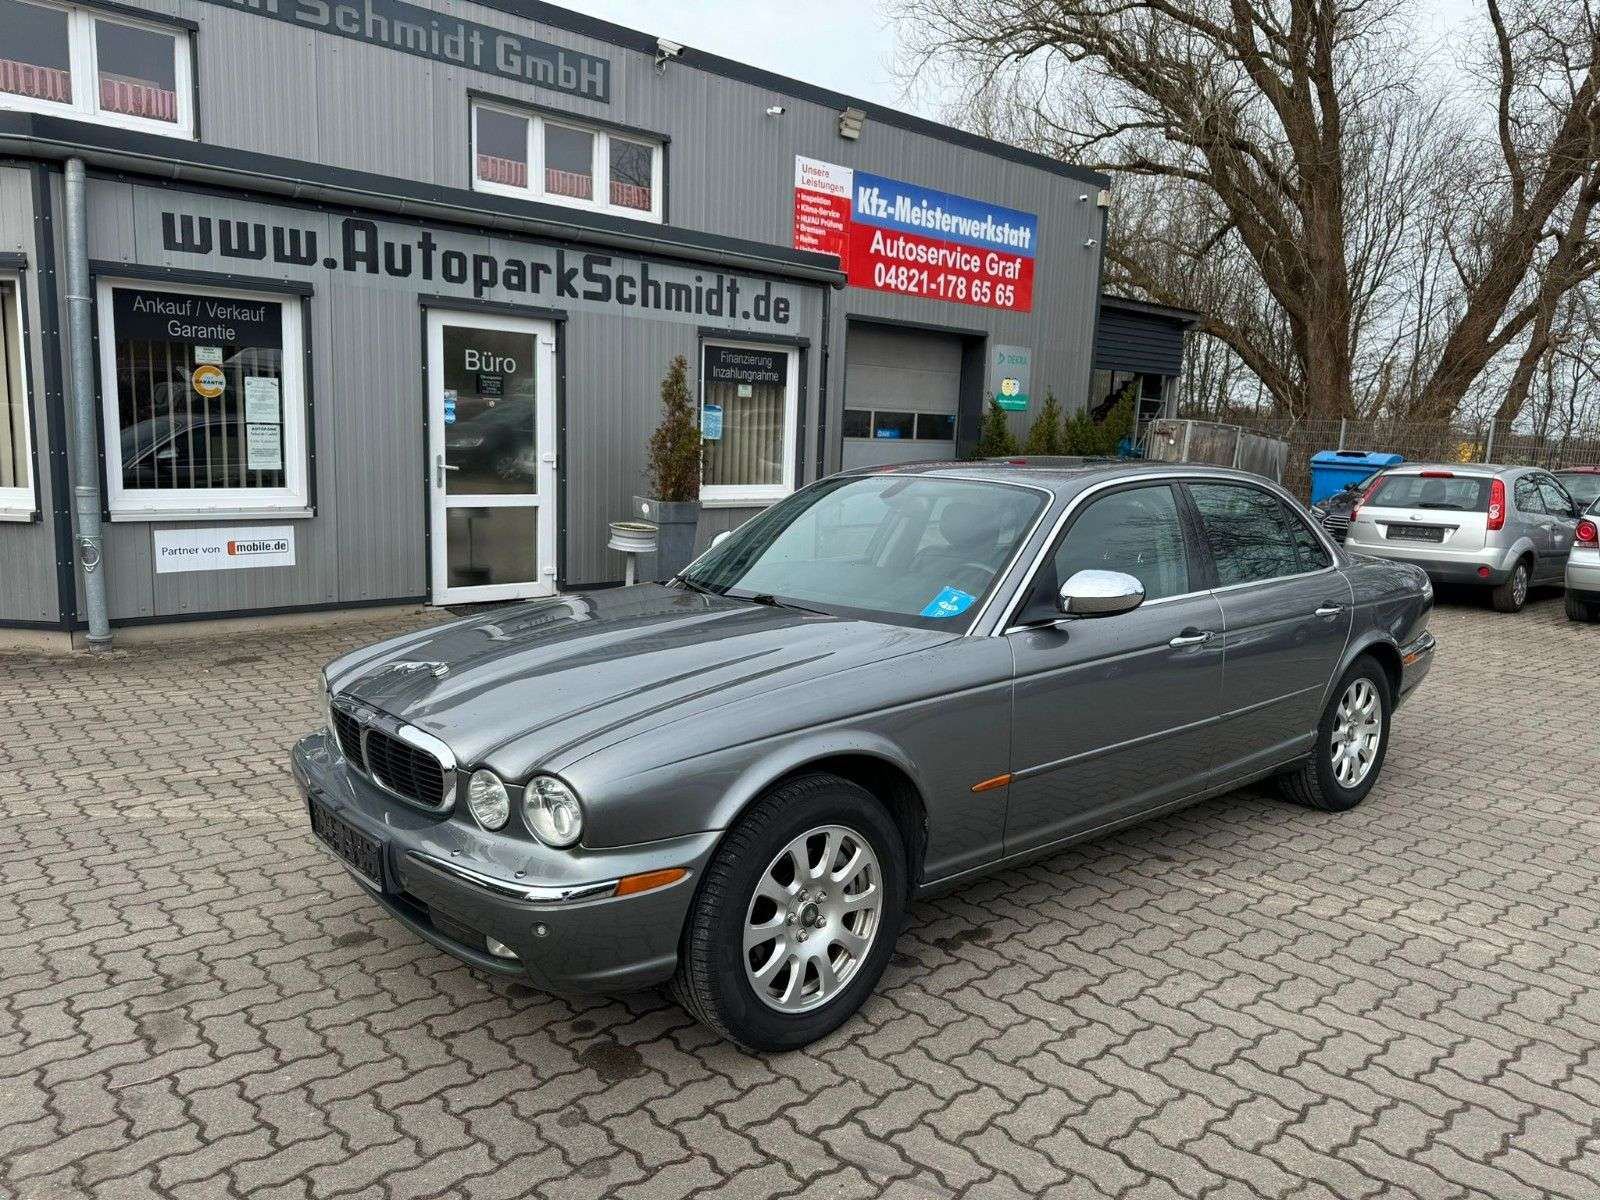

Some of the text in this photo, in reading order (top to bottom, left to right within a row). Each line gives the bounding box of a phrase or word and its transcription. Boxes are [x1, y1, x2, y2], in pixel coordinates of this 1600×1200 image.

[495, 34, 605, 97] GmbH
[802, 164, 830, 178] Unsere
[801, 175, 845, 193] Leistungen
[857, 186, 1031, 249] Kfz-Meisterwerkstatt
[870, 230, 1022, 279] Autoservice Graf
[161, 211, 791, 325] www.AutoparkSchmidt.de
[874, 263, 1015, 306] 04821-178 65 65
[133, 295, 192, 316] Ankauf
[205, 302, 266, 322] Verkauf
[167, 319, 236, 340] Garantie
[465, 349, 517, 374] Büro
[720, 350, 772, 369] Finanzierung
[713, 365, 779, 382] Inzahlungnahme
[161, 540, 287, 556] Partner von mobile.de
